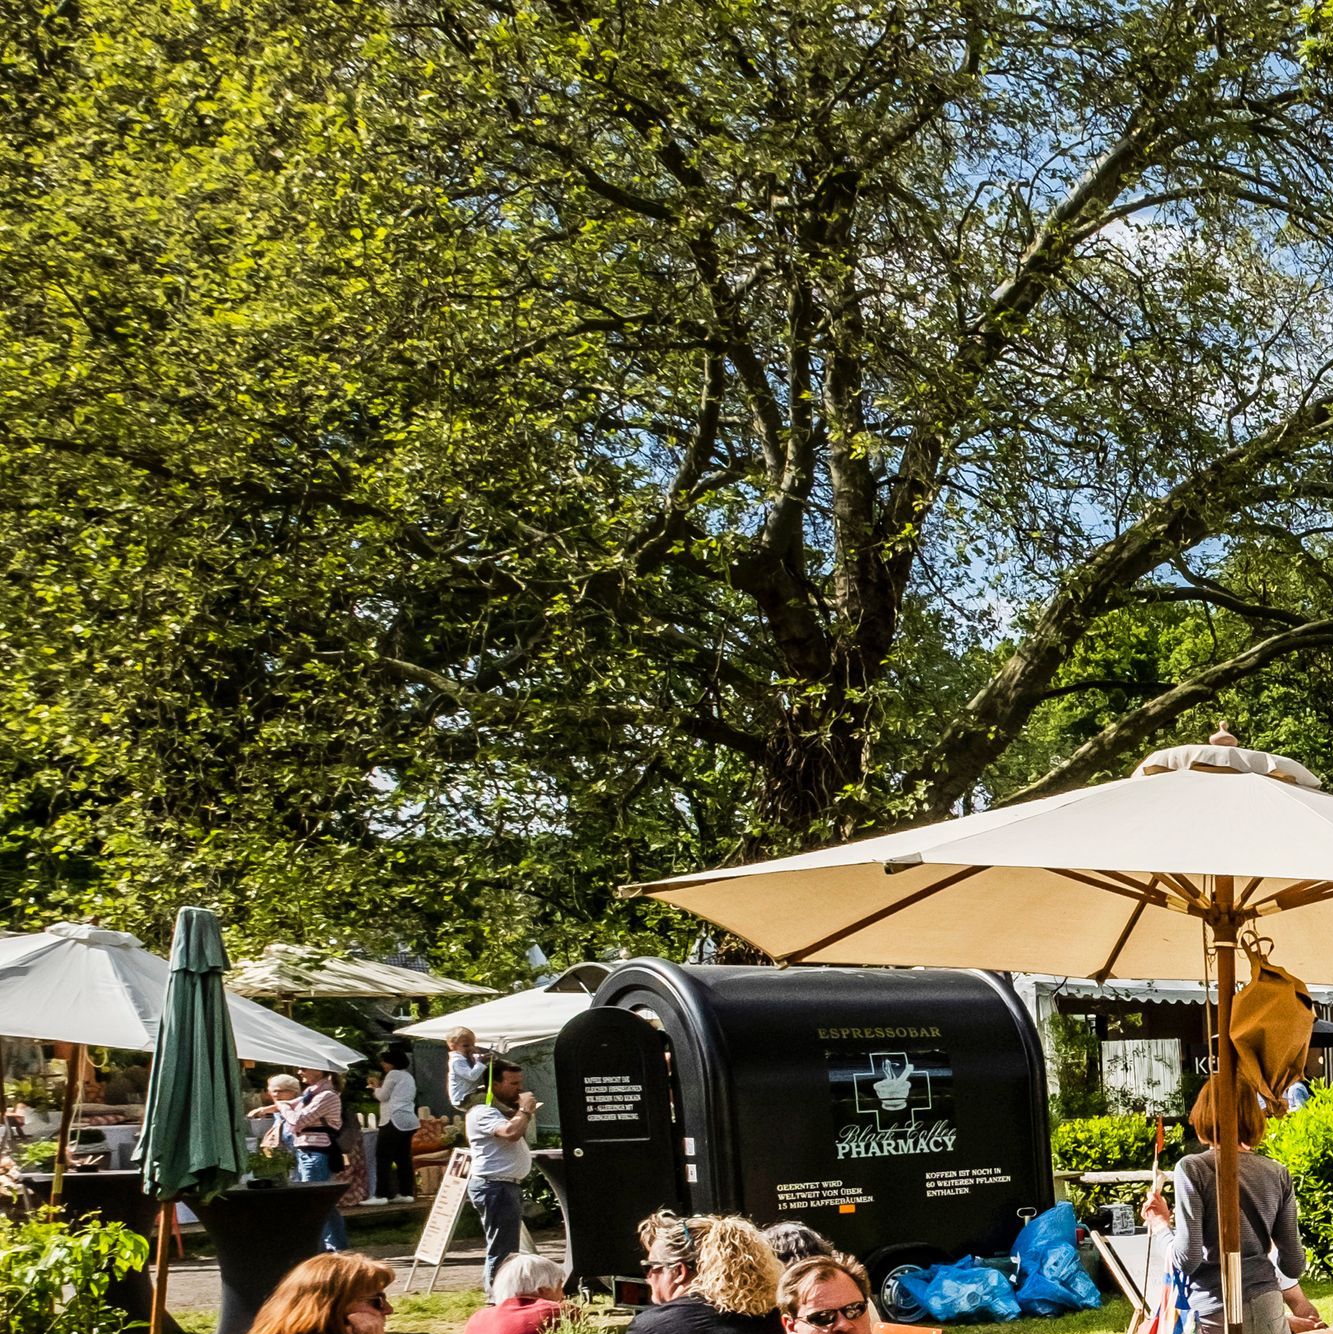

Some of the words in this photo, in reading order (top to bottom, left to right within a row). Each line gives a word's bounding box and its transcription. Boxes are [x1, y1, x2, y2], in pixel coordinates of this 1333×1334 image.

[817, 1026, 942, 1039] ESPRESSOBAR
[839, 1123, 895, 1144] Black
[905, 1120, 957, 1145] Coffee
[836, 1135, 957, 1160] PHARMACY
[926, 1171, 957, 1180] KOFFEIN
[958, 1170, 971, 1178] IST
[972, 1168, 993, 1177] NOCH
[995, 1167, 1003, 1175] IN
[776, 1182, 820, 1192] GEERNTET
[821, 1180, 843, 1189] WIRD
[926, 1181, 935, 1189] 60
[936, 1178, 974, 1188] WEITEREN
[975, 1175, 1011, 1185] PFLANZEN
[777, 1191, 820, 1201] WELTWEIT
[822, 1189, 839, 1198] VON
[841, 1187, 863, 1196] ÜBER
[778, 1202, 788, 1211] 15
[790, 1201, 808, 1210] MRD
